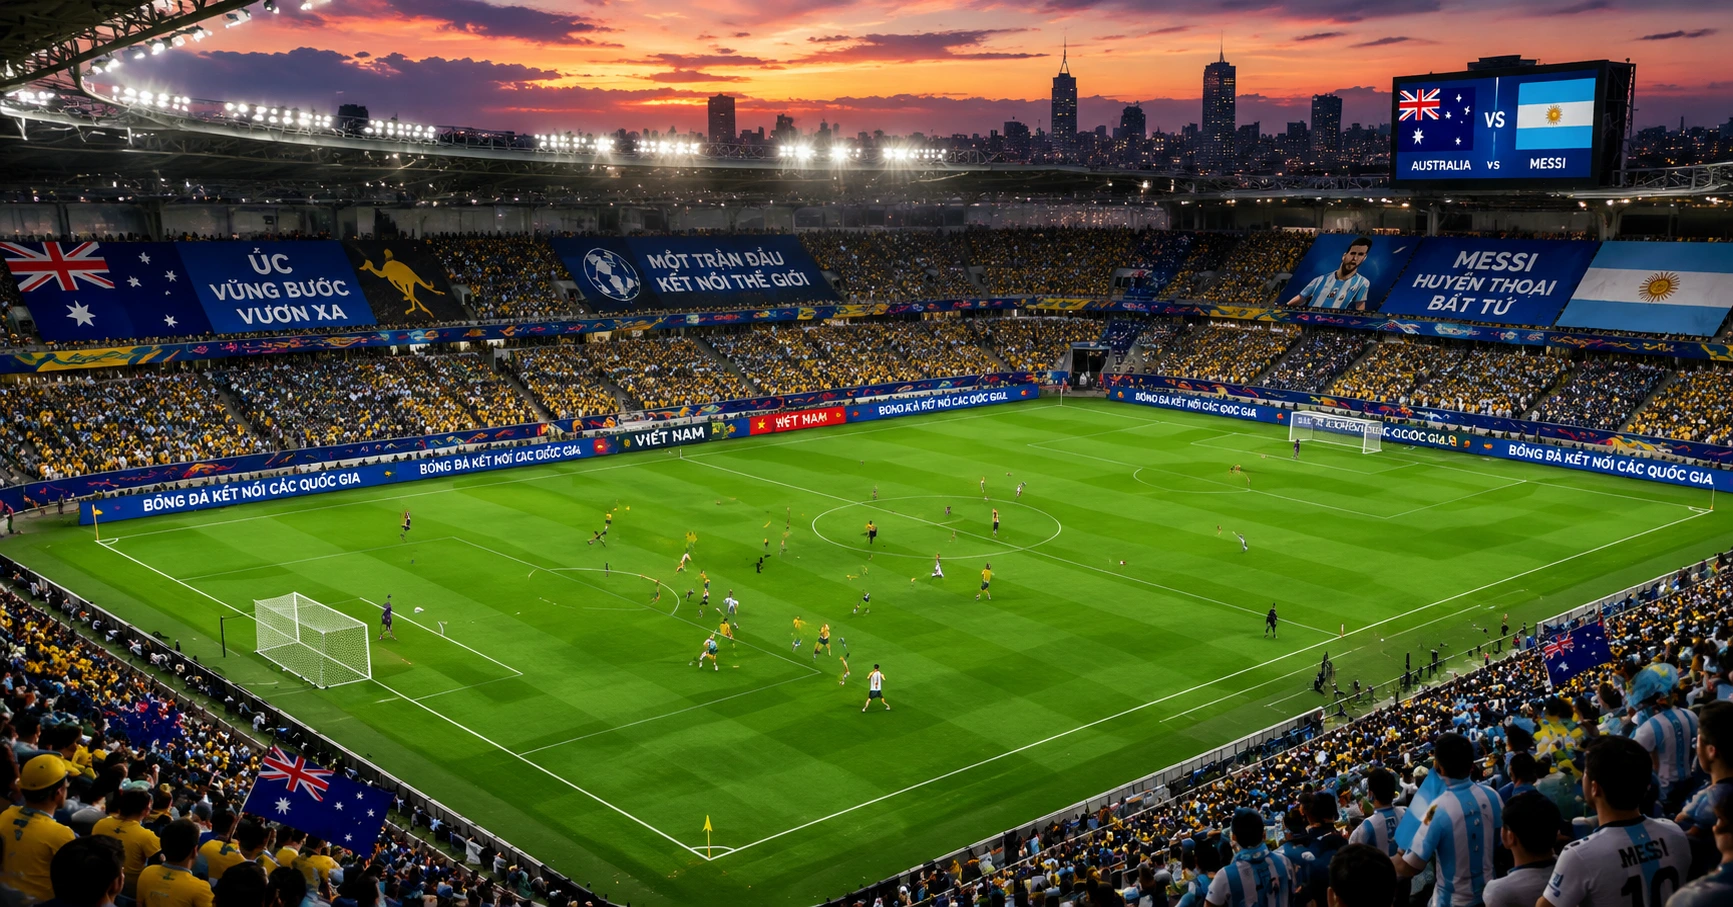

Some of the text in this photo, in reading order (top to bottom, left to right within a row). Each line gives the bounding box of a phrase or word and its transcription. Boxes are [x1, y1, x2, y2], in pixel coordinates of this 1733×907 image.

[1485, 111, 1506, 128] VS
[1411, 159, 1472, 171] AUSTRALIA
[1529, 157, 1567, 169] MESSI
[1452, 250, 1540, 272] MESSI
[236, 304, 348, 325] VƯƠN XA
[672, 426, 705, 442] NAM
[338, 472, 361, 485] GIA
[1689, 471, 1714, 485] GIA
